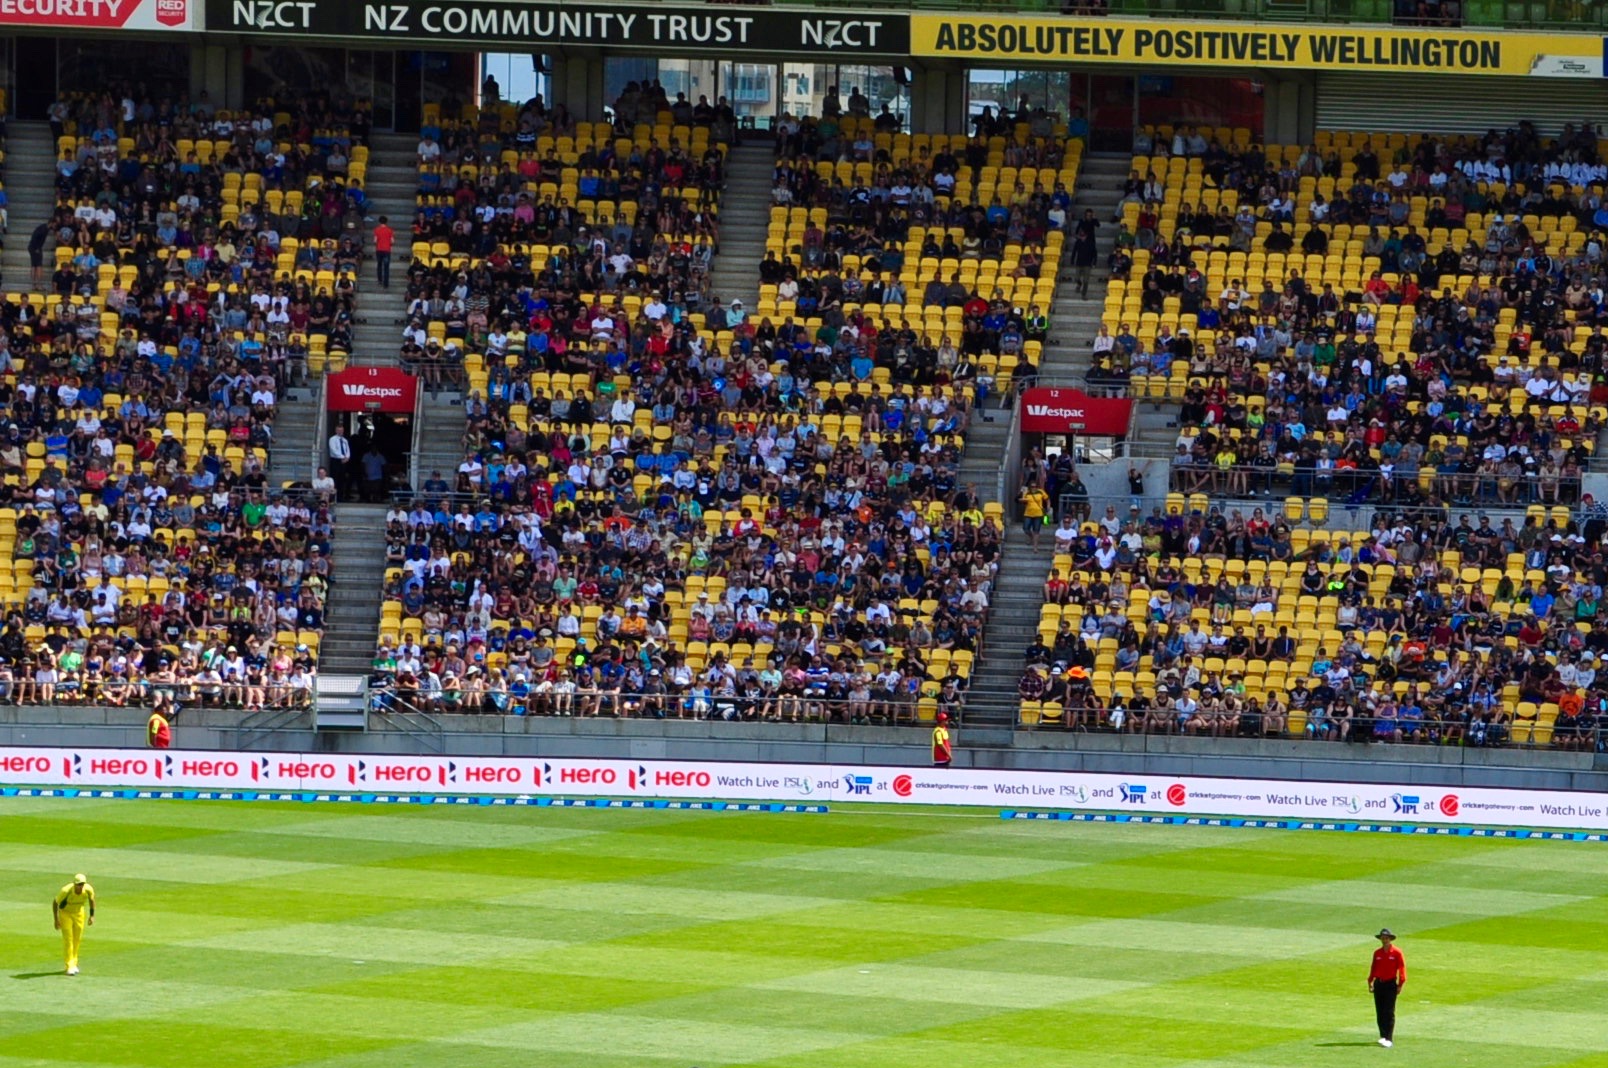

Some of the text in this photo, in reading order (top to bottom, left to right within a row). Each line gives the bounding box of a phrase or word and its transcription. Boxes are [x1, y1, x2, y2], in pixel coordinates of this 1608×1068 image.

[158, 1, 184, 11] RED
[233, 1, 316, 29] NZCT
[365, 5, 754, 43] NZ COMMUNITY TRUST
[801, 19, 882, 48] NZCT
[935, 23, 1500, 68] ABSOLUTELY POSITIVELY WELLINGTON
[368, 368, 378, 376] 13
[343, 384, 402, 398] Westpac
[1050, 390, 1059, 398] 12
[1027, 404, 1084, 418] Westpac
[717, 776, 753, 786] Watch
[756, 778, 779, 787] Live
[783, 778, 804, 789] PSL
[817, 780, 839, 788] and
[855, 785, 871, 794] IPL
[877, 782, 887, 790] at
[994, 784, 1029, 794] Watch
[1032, 785, 1055, 795] Live
[1060, 786, 1079, 795] PSL
[1092, 788, 1113, 797] and
[1130, 794, 1145, 803] IPL
[1151, 791, 1161, 799] at
[1267, 794, 1301, 804] Watch
[1305, 796, 1327, 806] Live
[1333, 796, 1352, 805] PSL
[1365, 798, 1386, 808] and
[1402, 804, 1418, 814] IPL
[1424, 802, 1434, 810] at
[1540, 805, 1575, 815] Watch
[1579, 806, 1601, 816] Live
